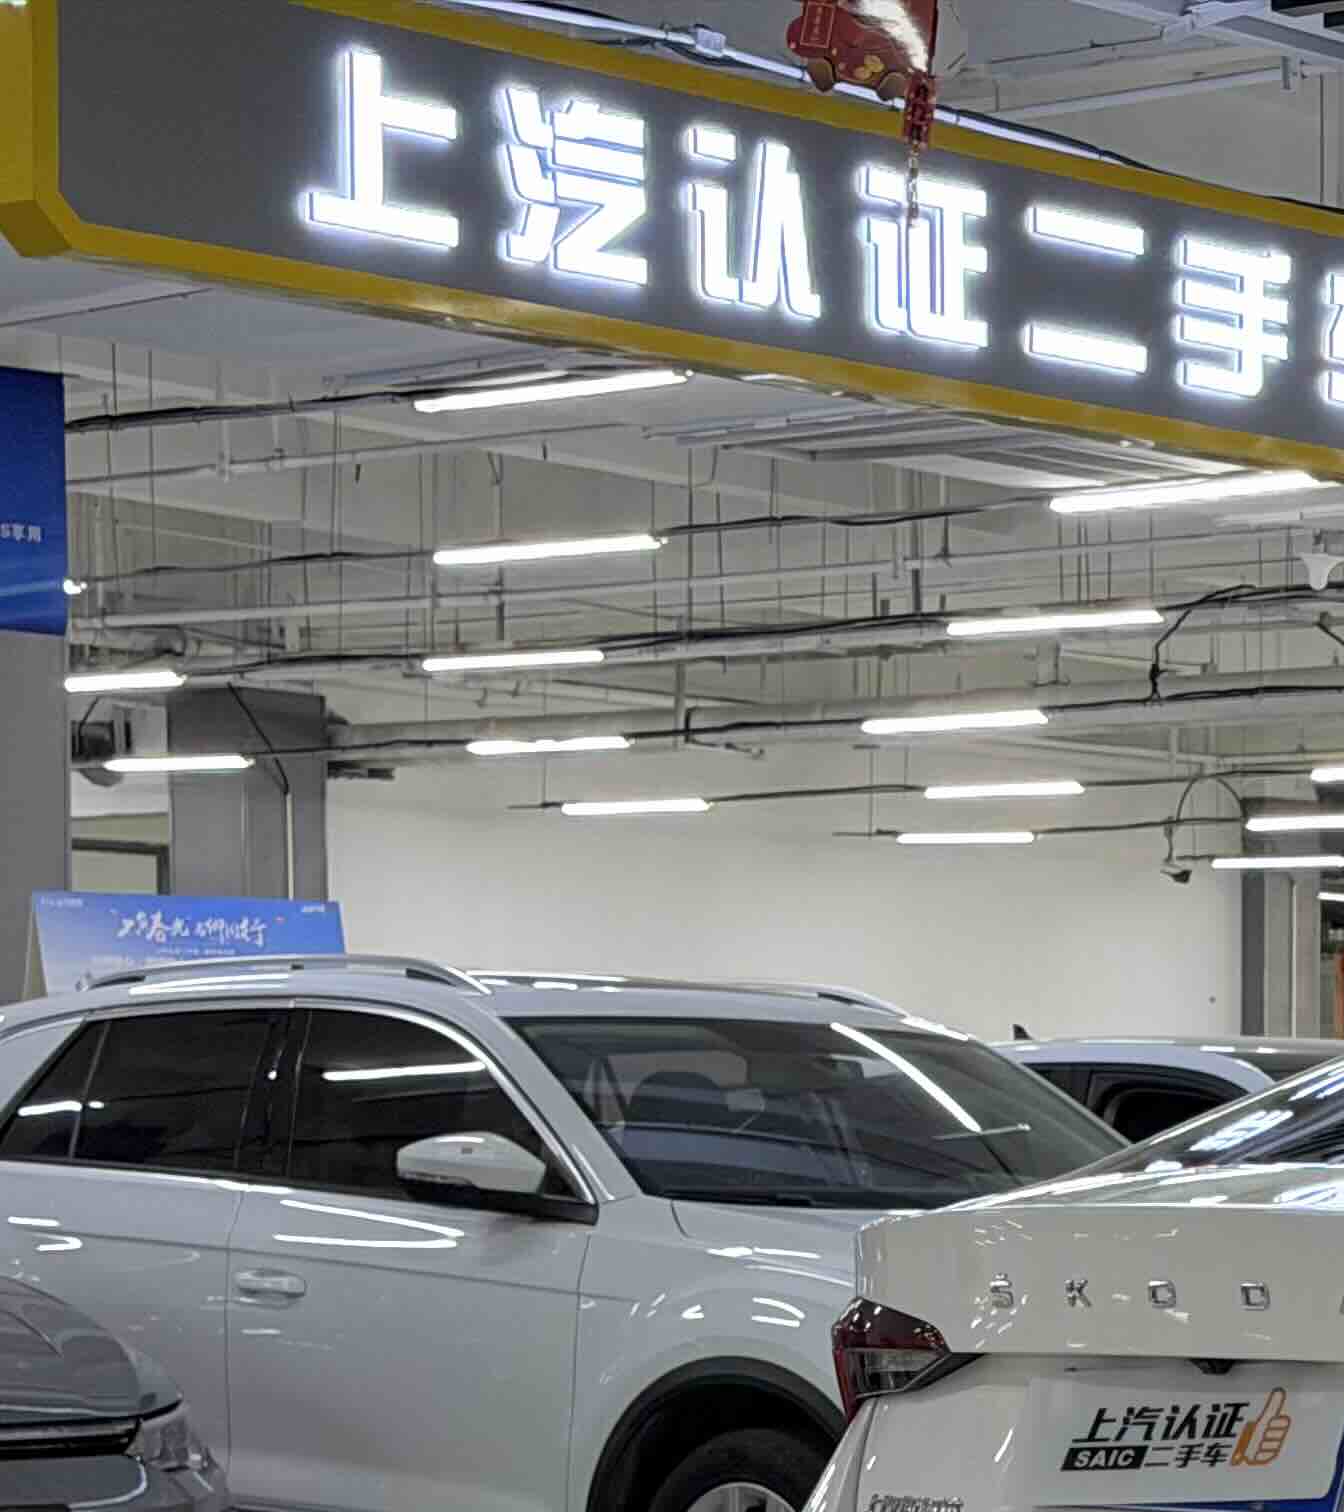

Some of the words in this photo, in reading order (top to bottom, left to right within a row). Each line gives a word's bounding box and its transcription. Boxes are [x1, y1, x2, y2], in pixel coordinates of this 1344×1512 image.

[1072, 1401, 1250, 1443] 上汽认证
[1073, 1449, 1135, 1468] SAIC
[1144, 1442, 1233, 1469] 二手车
